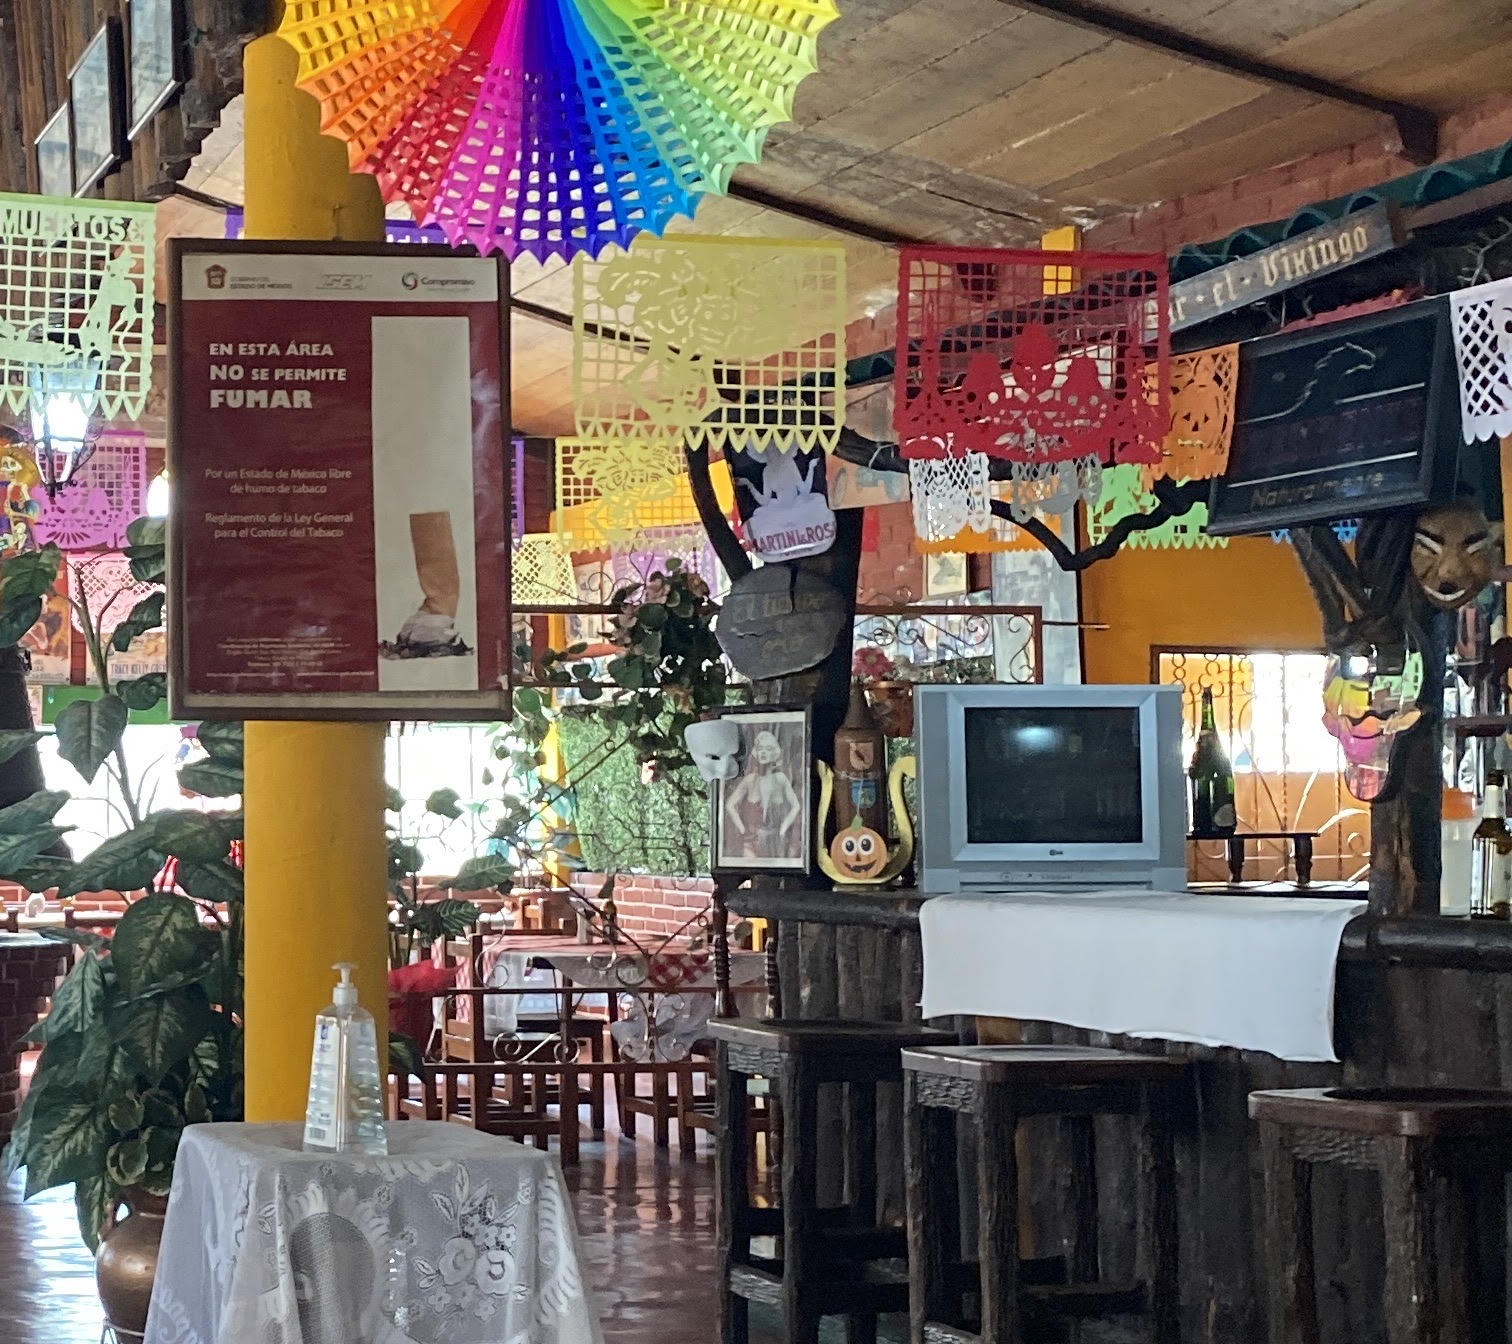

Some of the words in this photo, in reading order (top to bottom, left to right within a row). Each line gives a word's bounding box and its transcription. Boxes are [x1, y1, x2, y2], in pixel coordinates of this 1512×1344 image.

[209, 343, 233, 356] EN
[238, 343, 280, 356] ESTA
[285, 339, 334, 356] ÁREA
[210, 364, 245, 381] NO
[251, 368, 269, 381] SE
[274, 368, 347, 381] PERMITE
[210, 389, 313, 409] FUMAR
[205, 468, 223, 479] Por
[240, 468, 273, 479] Estado
[275, 468, 288, 479] de
[245, 483, 275, 494] humo
[292, 483, 328, 494] tabaco
[205, 512, 267, 525] Reglamento
[268, 512, 282, 523] de
[294, 512, 313, 524] Ley
[313, 512, 354, 523] General
[250, 527, 288, 538] Control
[289, 527, 306, 538] del
[307, 527, 344, 538] Tabaco
